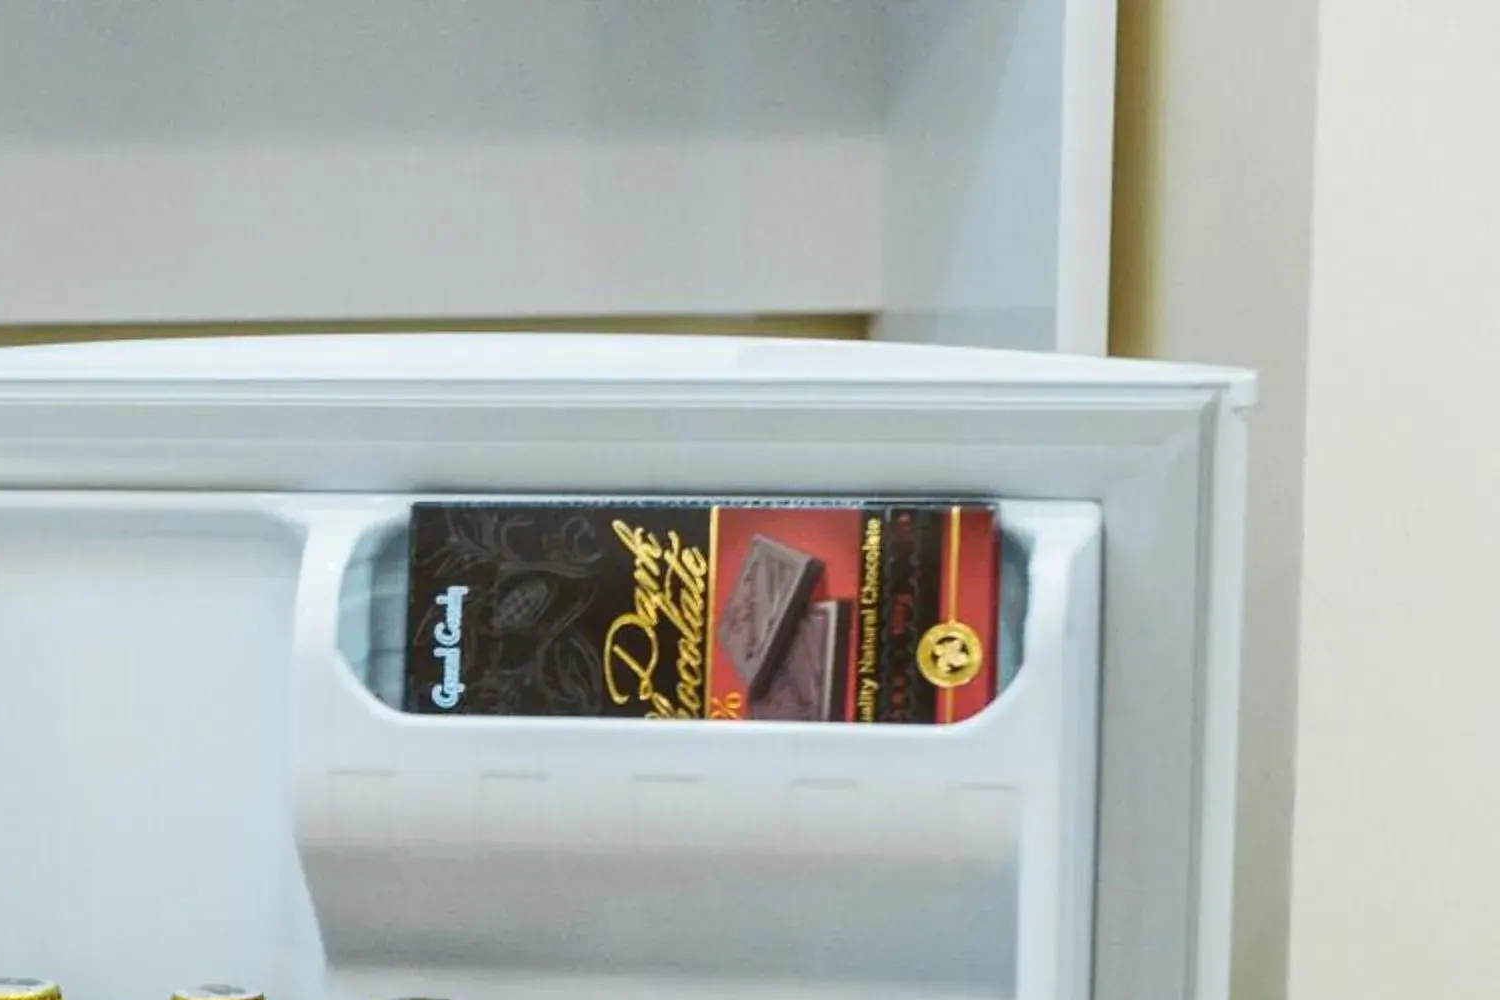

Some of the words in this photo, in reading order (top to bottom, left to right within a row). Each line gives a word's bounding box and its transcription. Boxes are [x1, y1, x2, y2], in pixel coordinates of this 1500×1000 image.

[604, 519, 663, 704] Dark
[645, 530, 708, 719] hocolate
[861, 517, 883, 605] Chocolate
[858, 608, 878, 674] Natural
